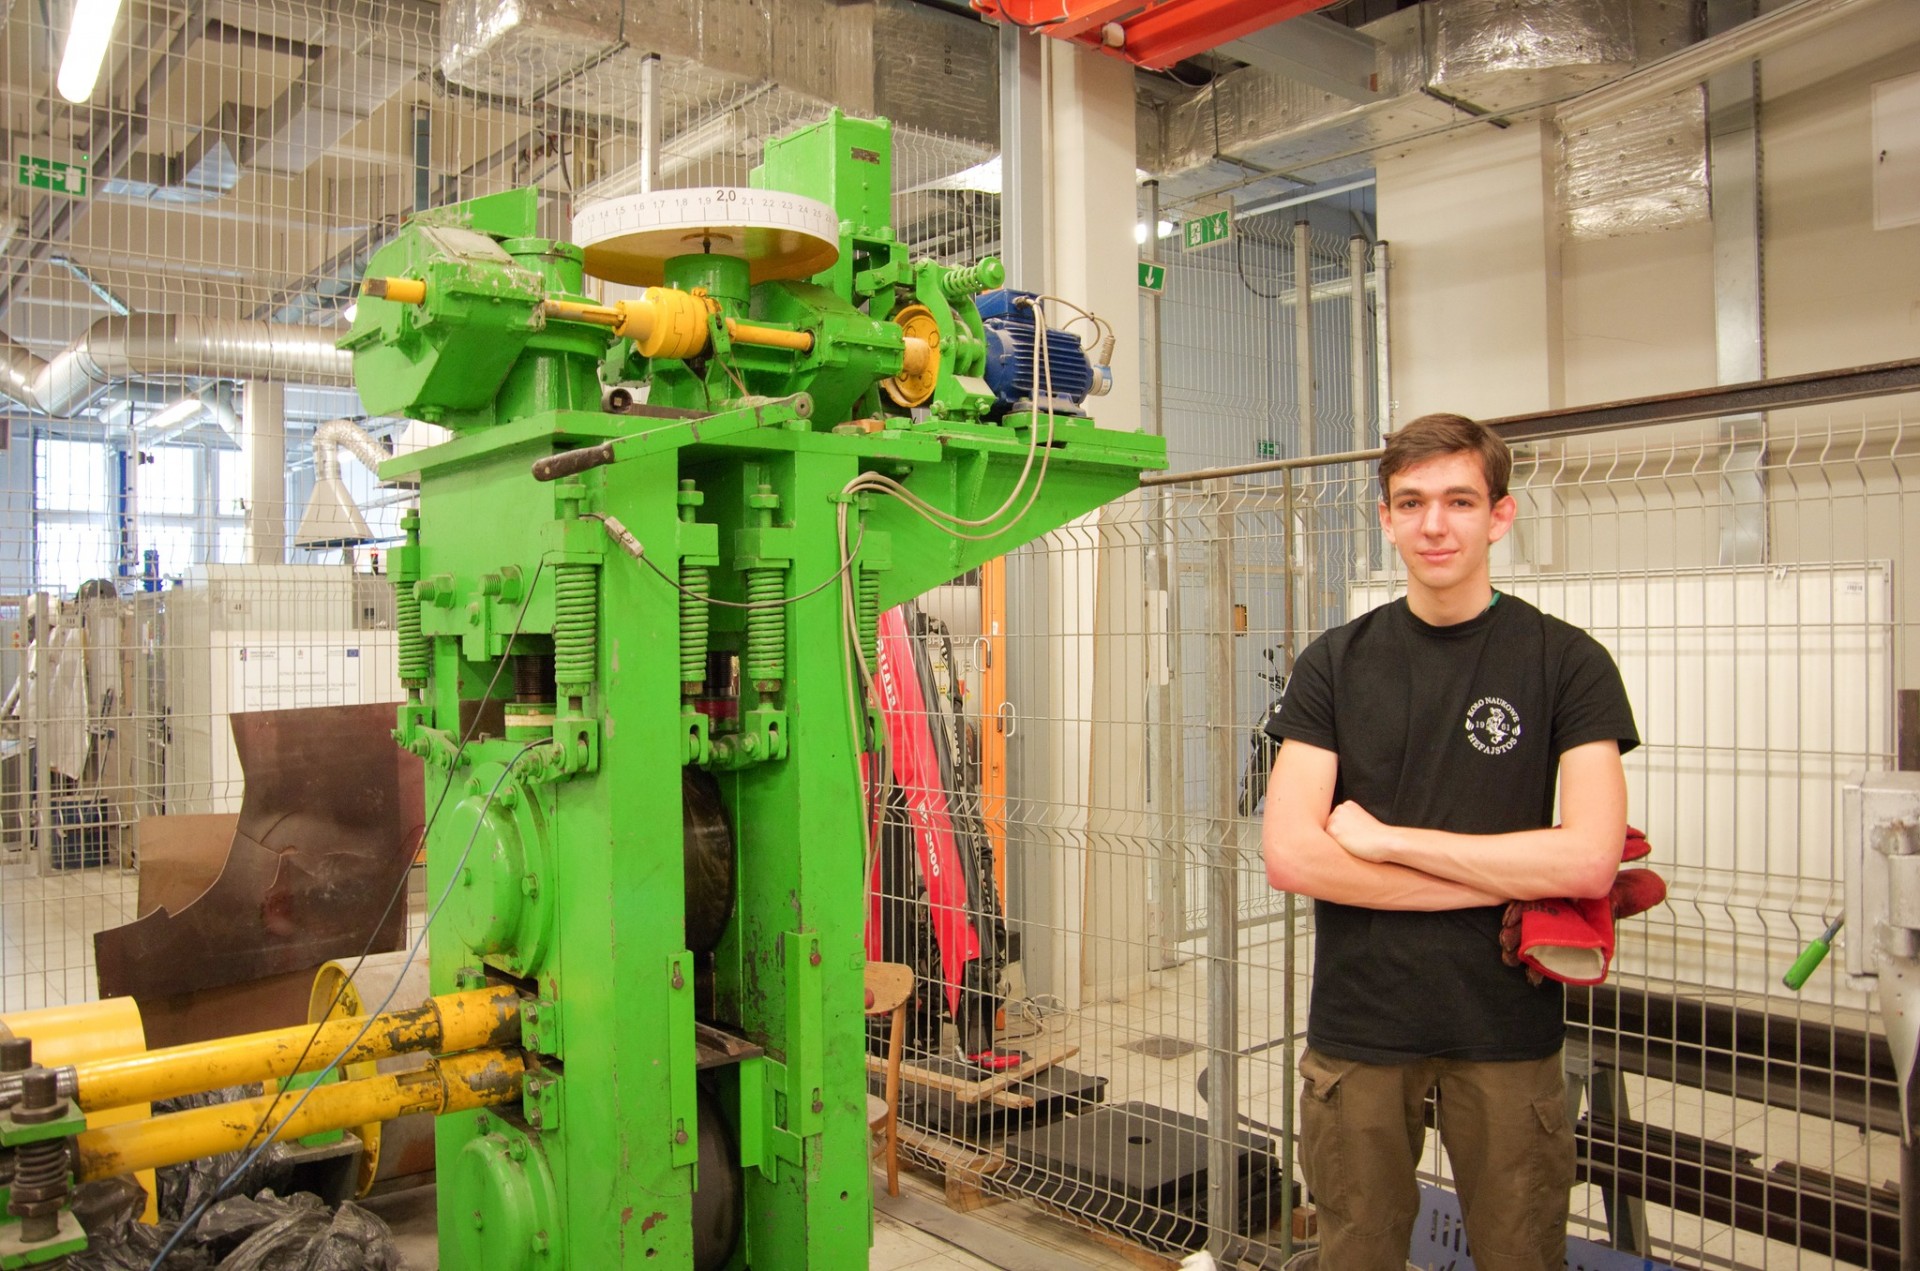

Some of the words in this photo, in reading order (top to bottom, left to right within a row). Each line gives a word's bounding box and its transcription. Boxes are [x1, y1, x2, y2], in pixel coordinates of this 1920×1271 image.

[1485, 696, 1520, 723] NAUKOWE
[1475, 720, 1486, 729] 19
[1501, 722, 1511, 732] 61
[1467, 733, 1518, 755] HEFAJSTOS
